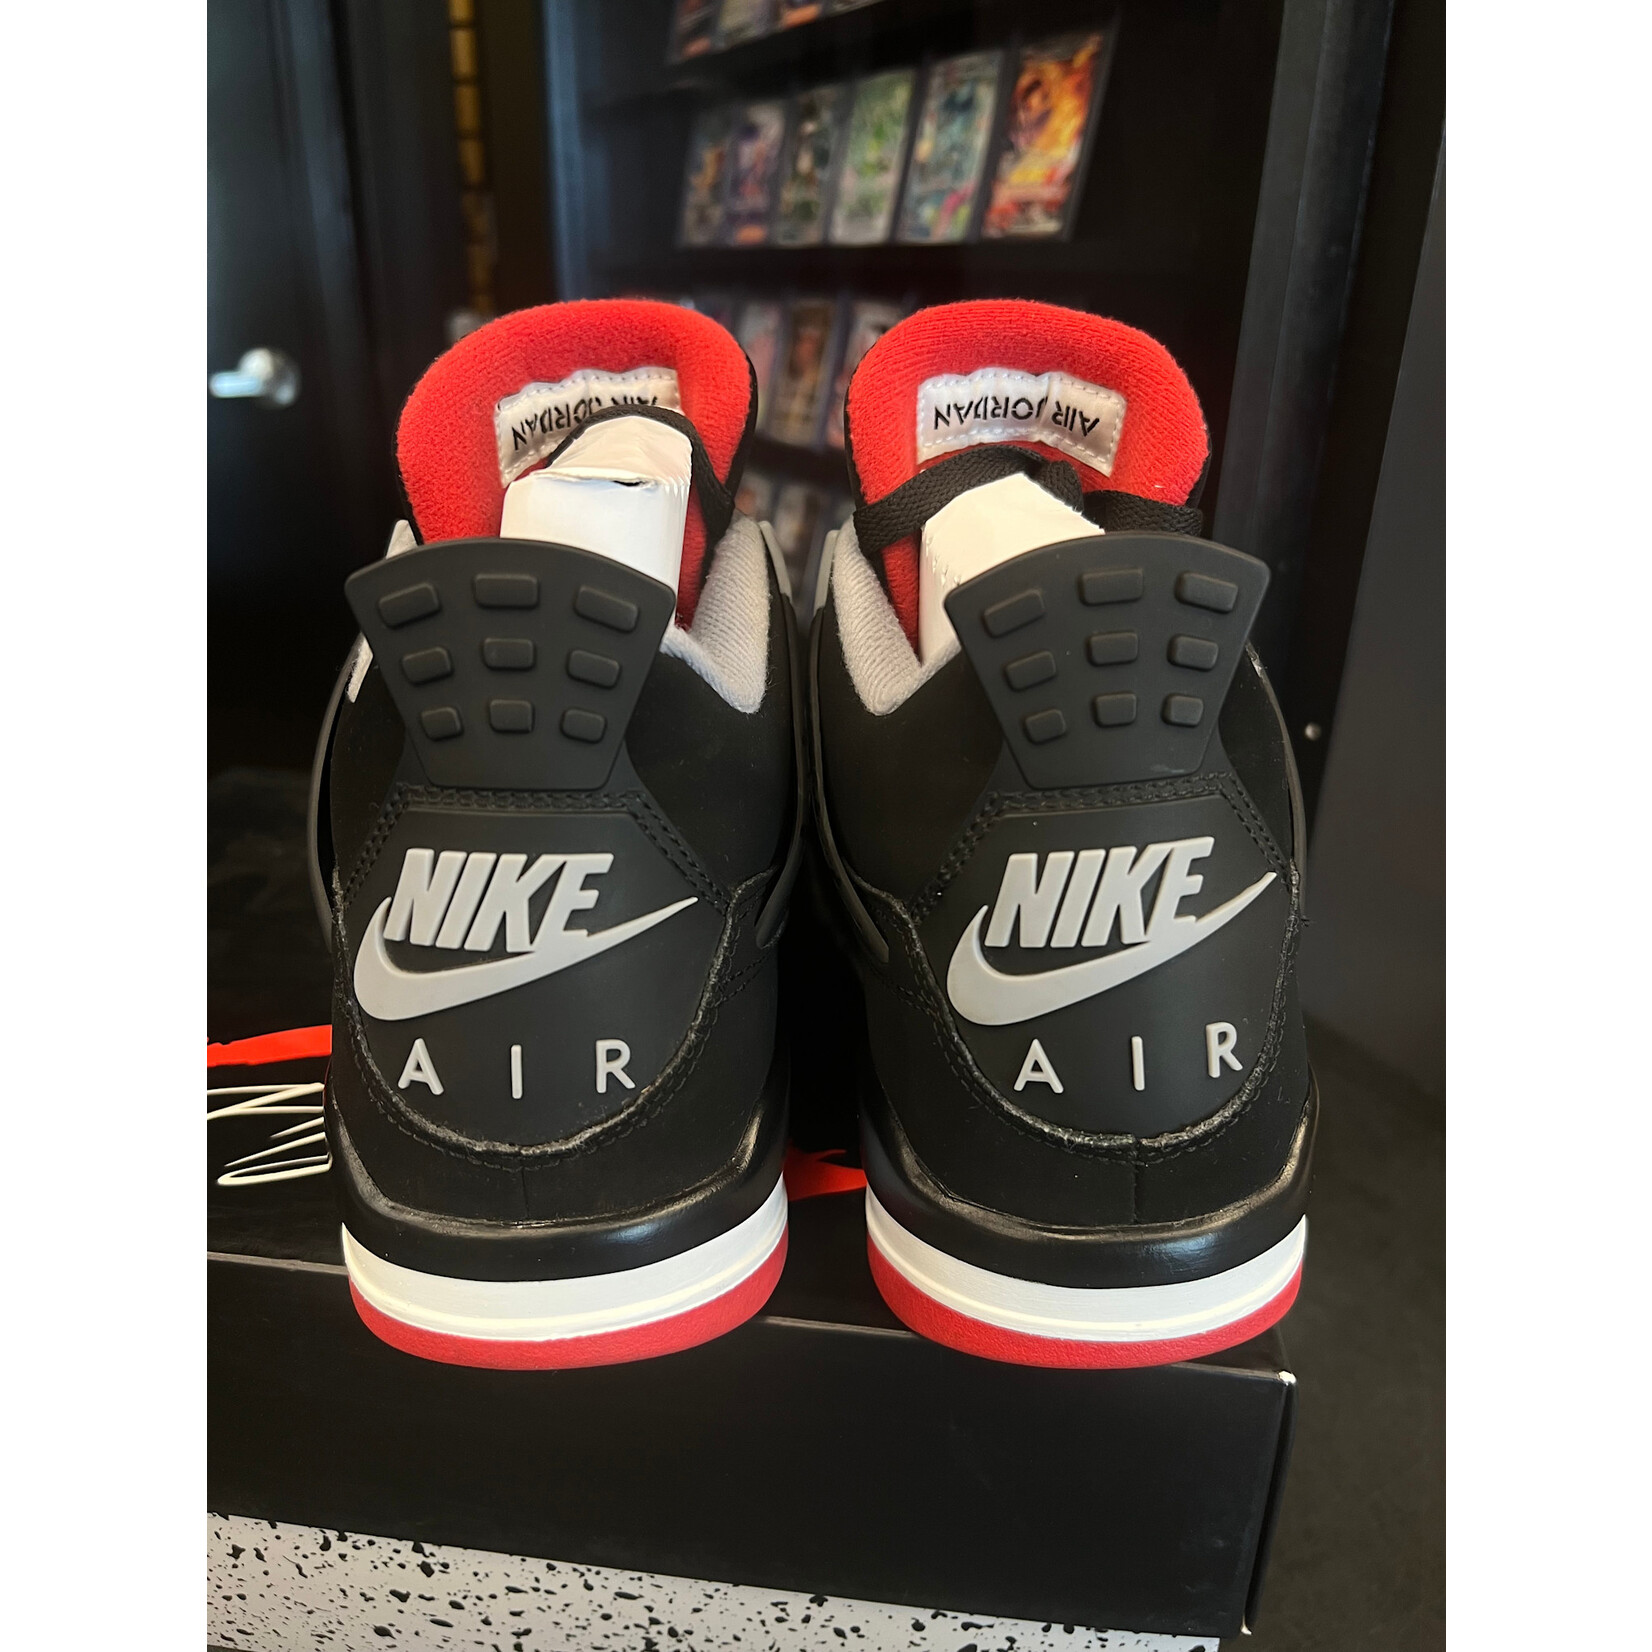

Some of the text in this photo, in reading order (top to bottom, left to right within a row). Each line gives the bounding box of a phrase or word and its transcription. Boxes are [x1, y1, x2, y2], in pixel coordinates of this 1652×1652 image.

[934, 396, 1100, 437] AIR JORDAN
[383, 848, 614, 953] NIKE
[984, 836, 1215, 948] NIKE
[397, 1038, 636, 1100] AIR
[1013, 1021, 1244, 1094] AIR
